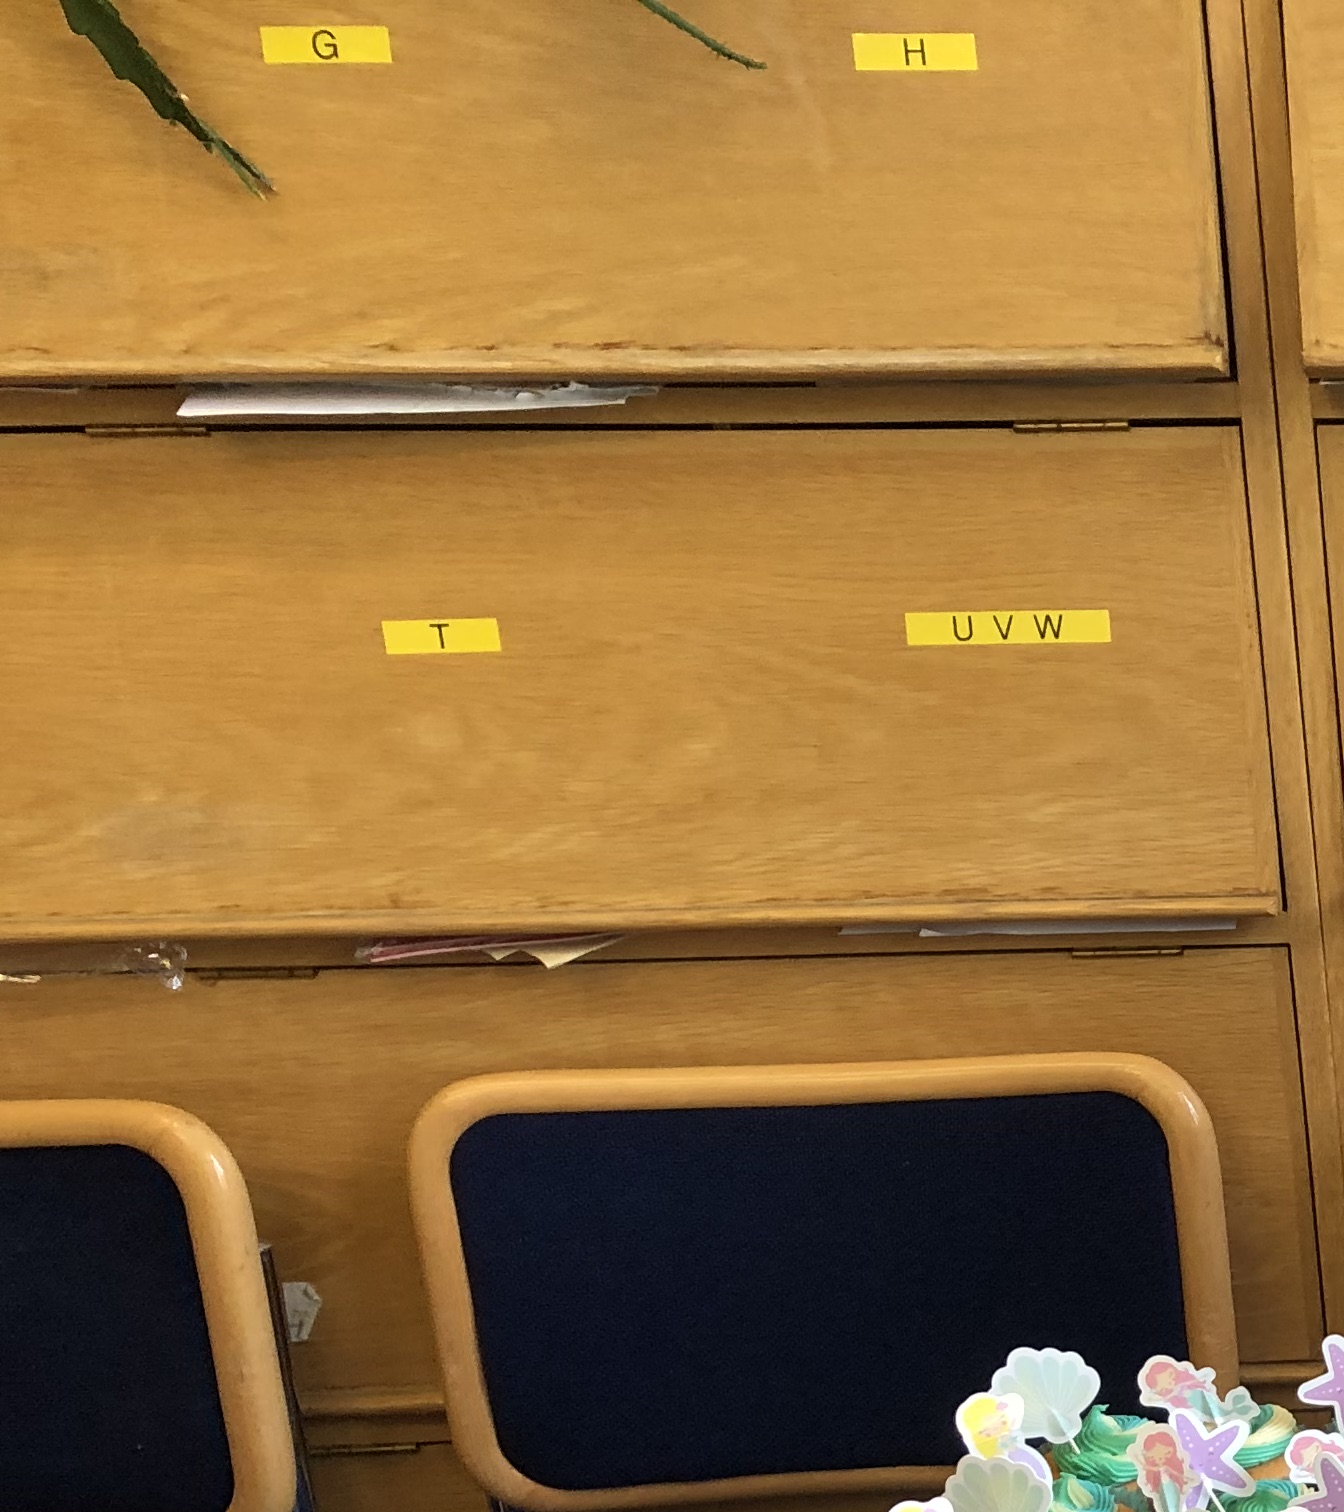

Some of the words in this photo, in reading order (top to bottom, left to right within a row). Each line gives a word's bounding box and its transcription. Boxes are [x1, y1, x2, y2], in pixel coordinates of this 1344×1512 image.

[312, 29, 338, 61] G
[904, 39, 925, 66] H
[429, 623, 450, 649] T
[952, 615, 974, 642] U
[992, 614, 1013, 641] V
[1033, 613, 1063, 640] W
